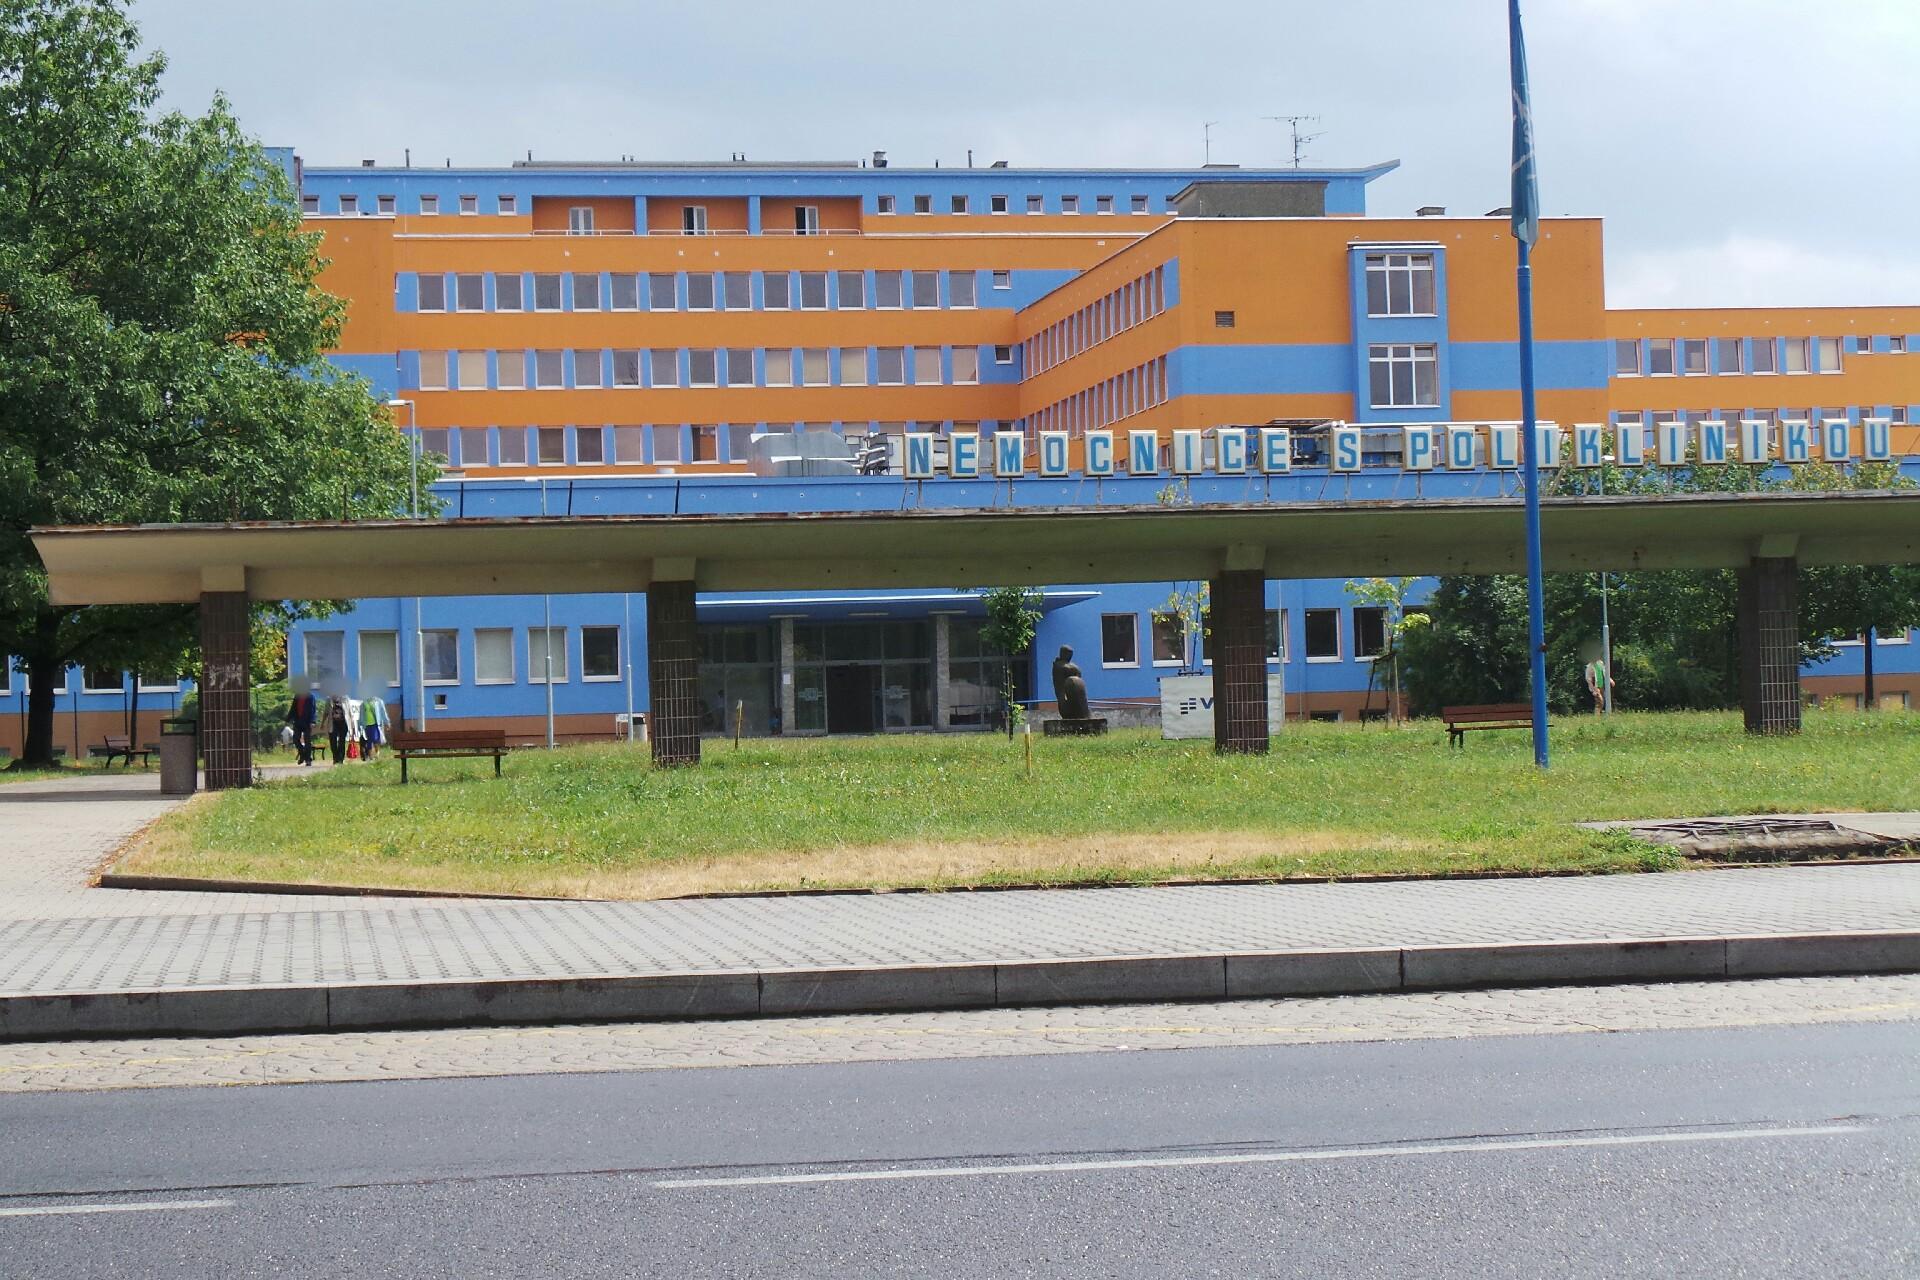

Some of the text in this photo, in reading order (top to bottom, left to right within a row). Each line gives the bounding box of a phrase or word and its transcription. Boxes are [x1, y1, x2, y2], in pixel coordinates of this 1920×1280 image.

[909, 423, 1887, 474] NEMOCNICE S POLIKLINIKOU
